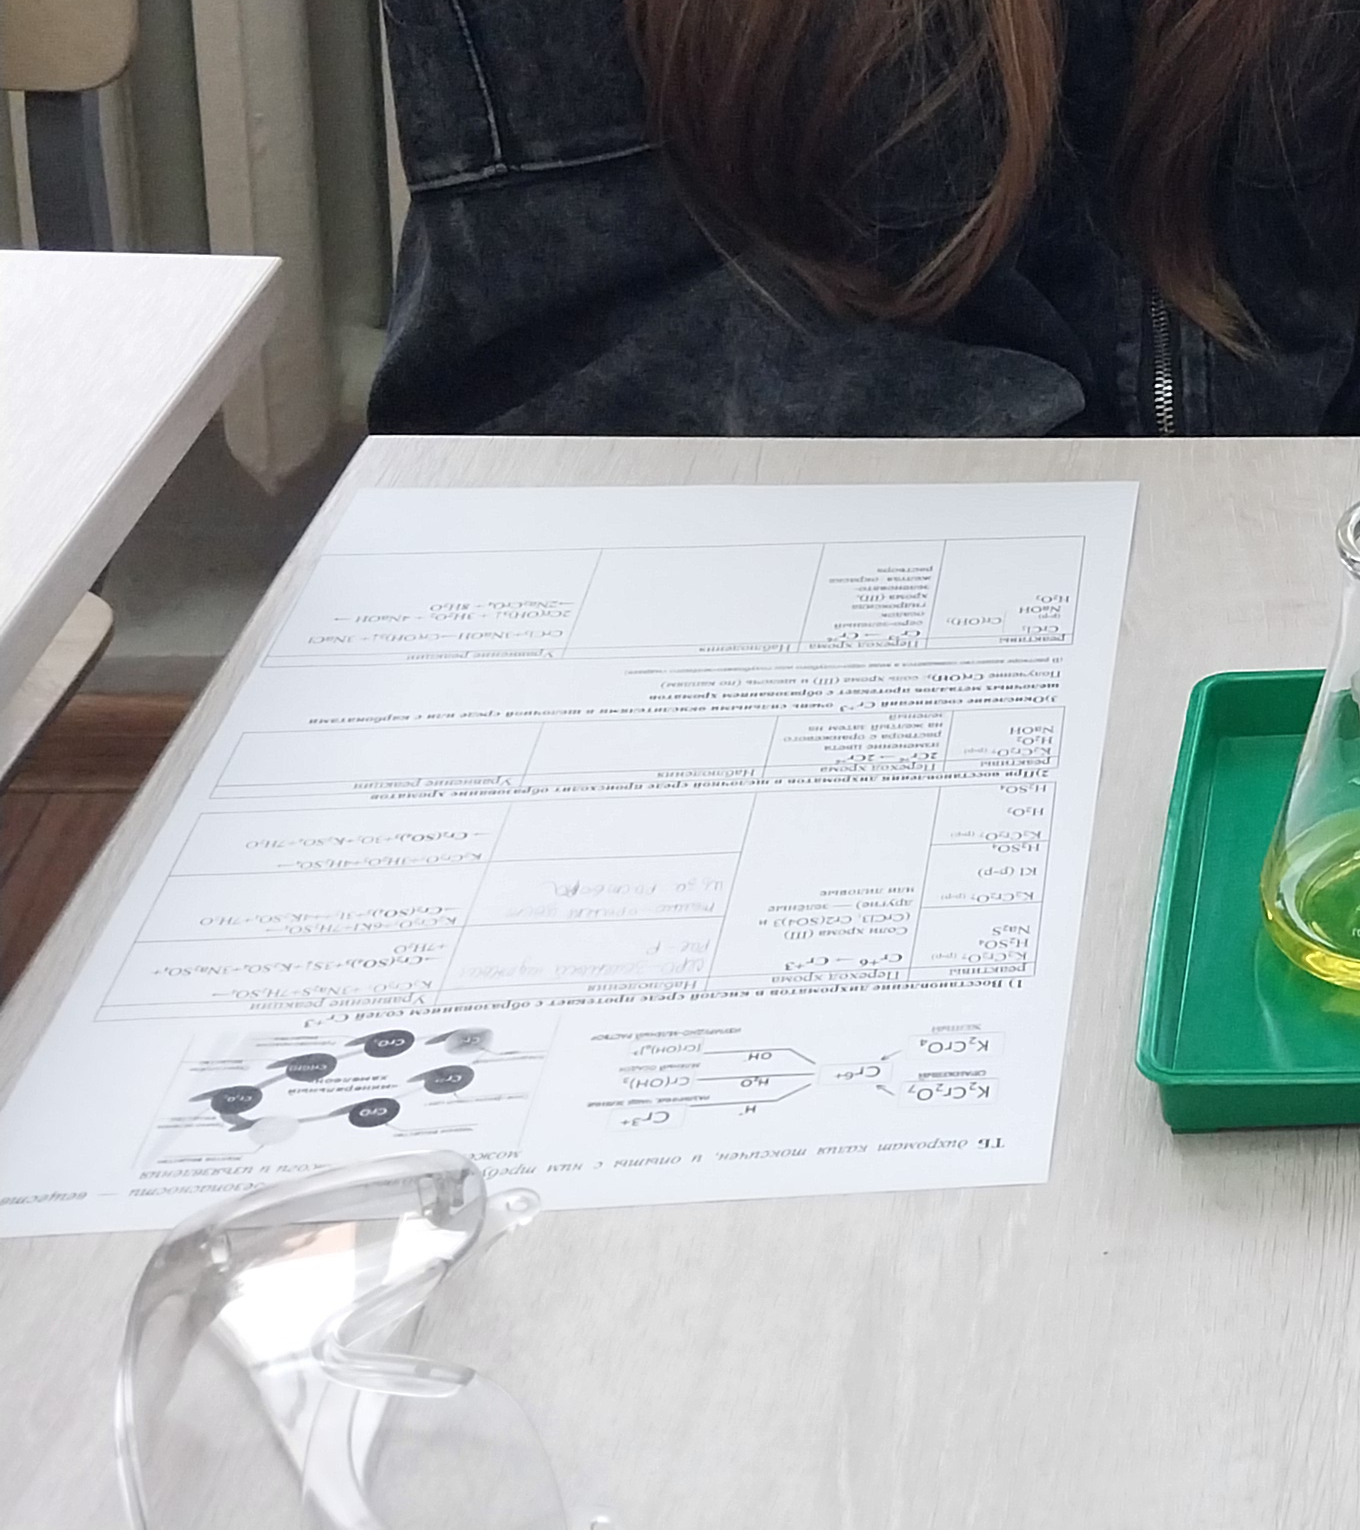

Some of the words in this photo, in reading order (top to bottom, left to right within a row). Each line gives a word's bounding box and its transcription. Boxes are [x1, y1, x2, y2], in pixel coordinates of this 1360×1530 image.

[878, 1138, 968, 1154] дихромат
[978, 1138, 1005, 1149] ТБ
[468, 1151, 521, 1162] може
[715, 1148, 807, 1162] токсичен,
[817, 1144, 868, 1158] калия
[614, 1156, 681, 1169] опыты
[692, 1154, 702, 1165] и
[548, 1164, 583, 1176] ним
[128, 1181, 266, 1197] езопасности
[0, 1189, 88, 1205] веществ
